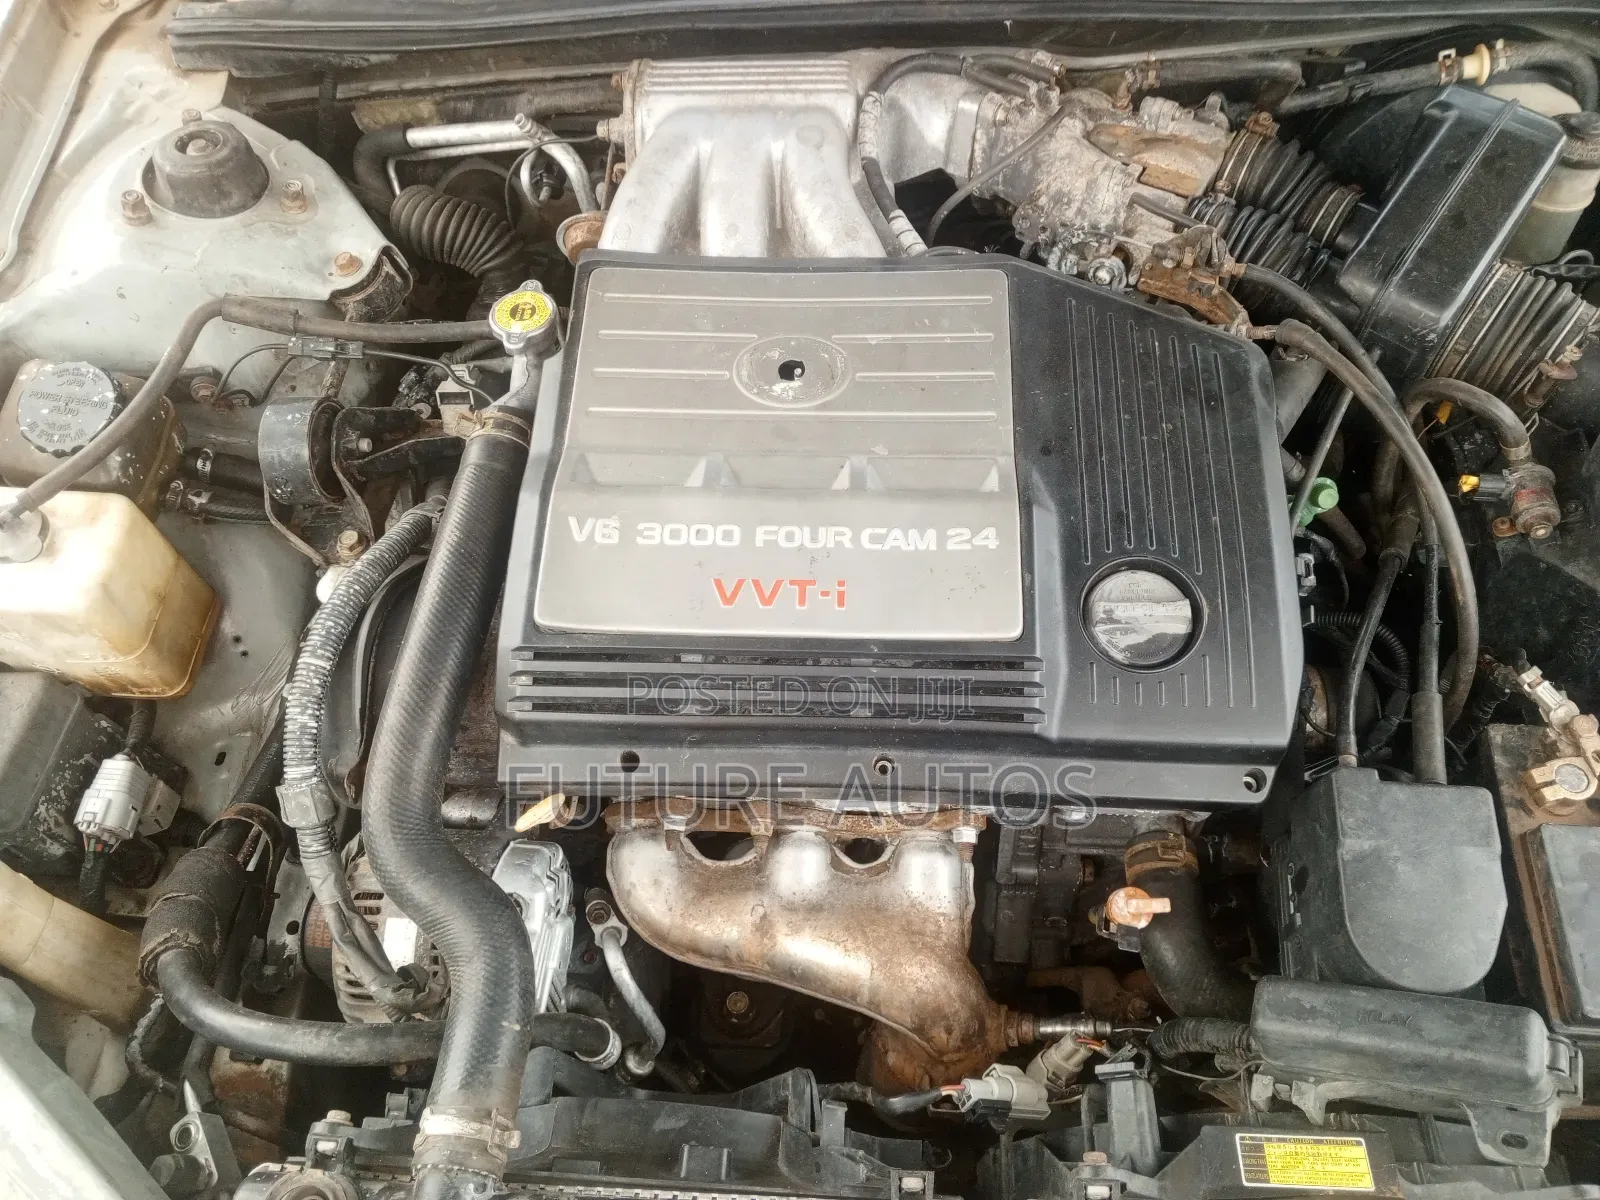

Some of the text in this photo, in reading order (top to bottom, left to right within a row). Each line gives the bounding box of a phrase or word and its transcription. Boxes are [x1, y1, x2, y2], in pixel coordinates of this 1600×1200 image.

[29, 390, 109, 410] POWER STEERING
[50, 405, 79, 417] FLUID
[567, 515, 1000, 551] V6 3000 FOUR CAM 24
[712, 577, 848, 610] VVT-i
